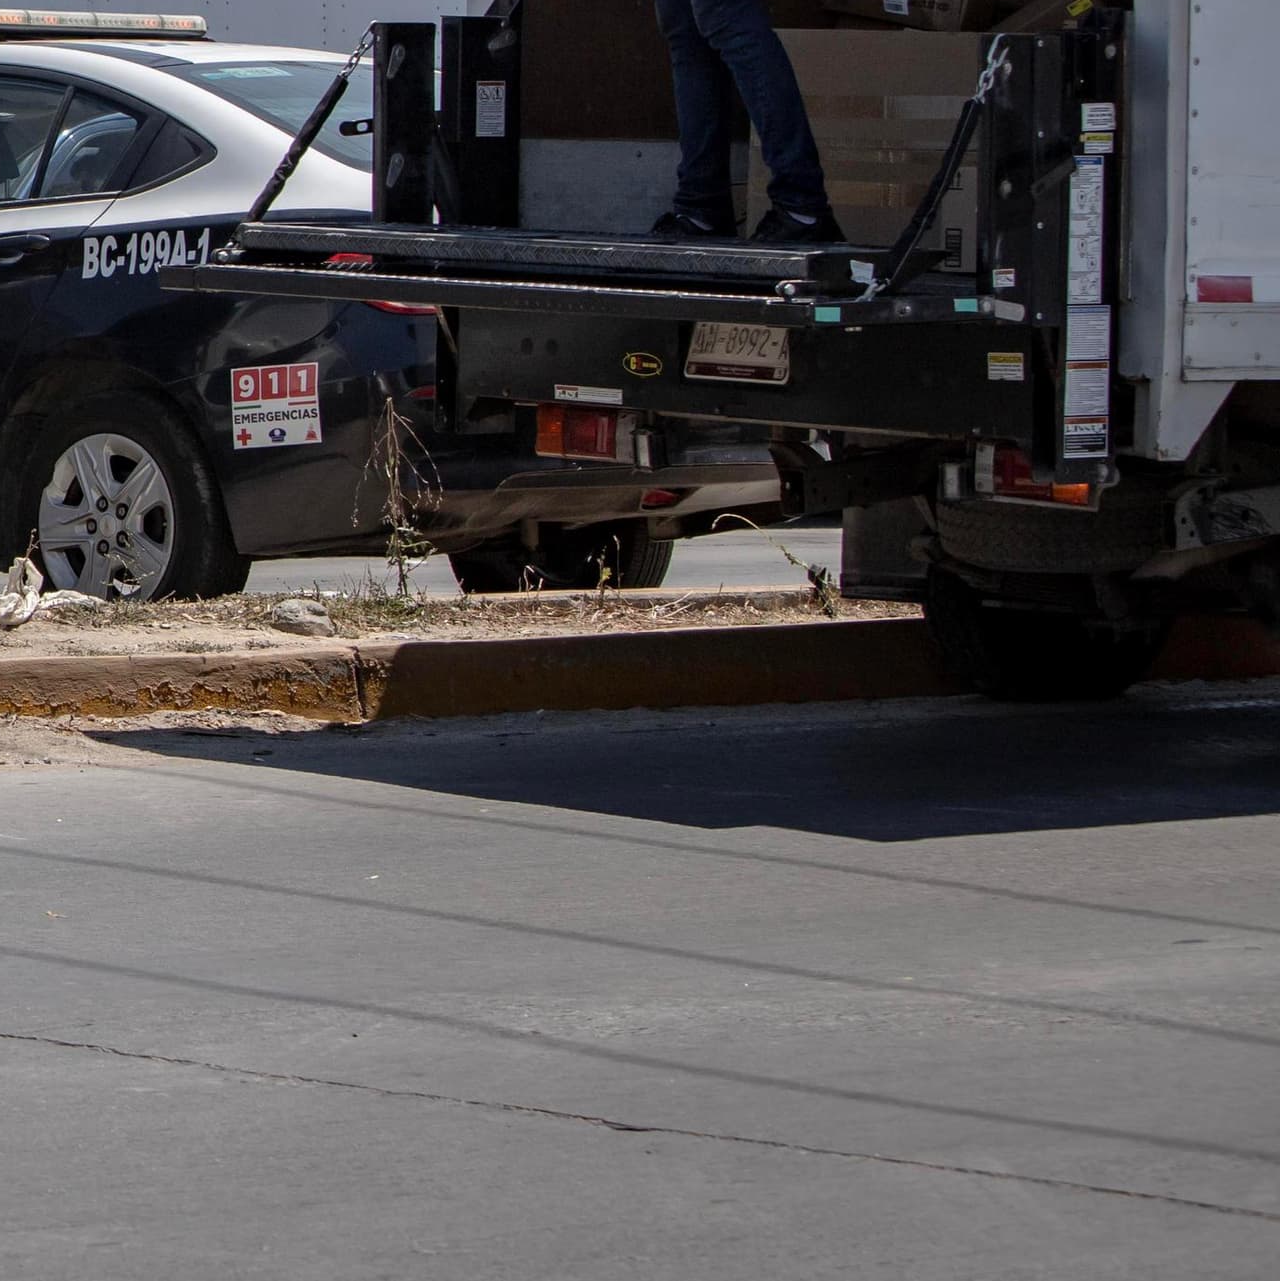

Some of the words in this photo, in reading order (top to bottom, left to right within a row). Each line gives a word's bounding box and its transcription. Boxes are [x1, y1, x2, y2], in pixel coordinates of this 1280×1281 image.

[82, 227, 210, 279] BC-199A-1
[238, 368, 308, 398] 911
[234, 408, 318, 425] EMERGENCIAS
